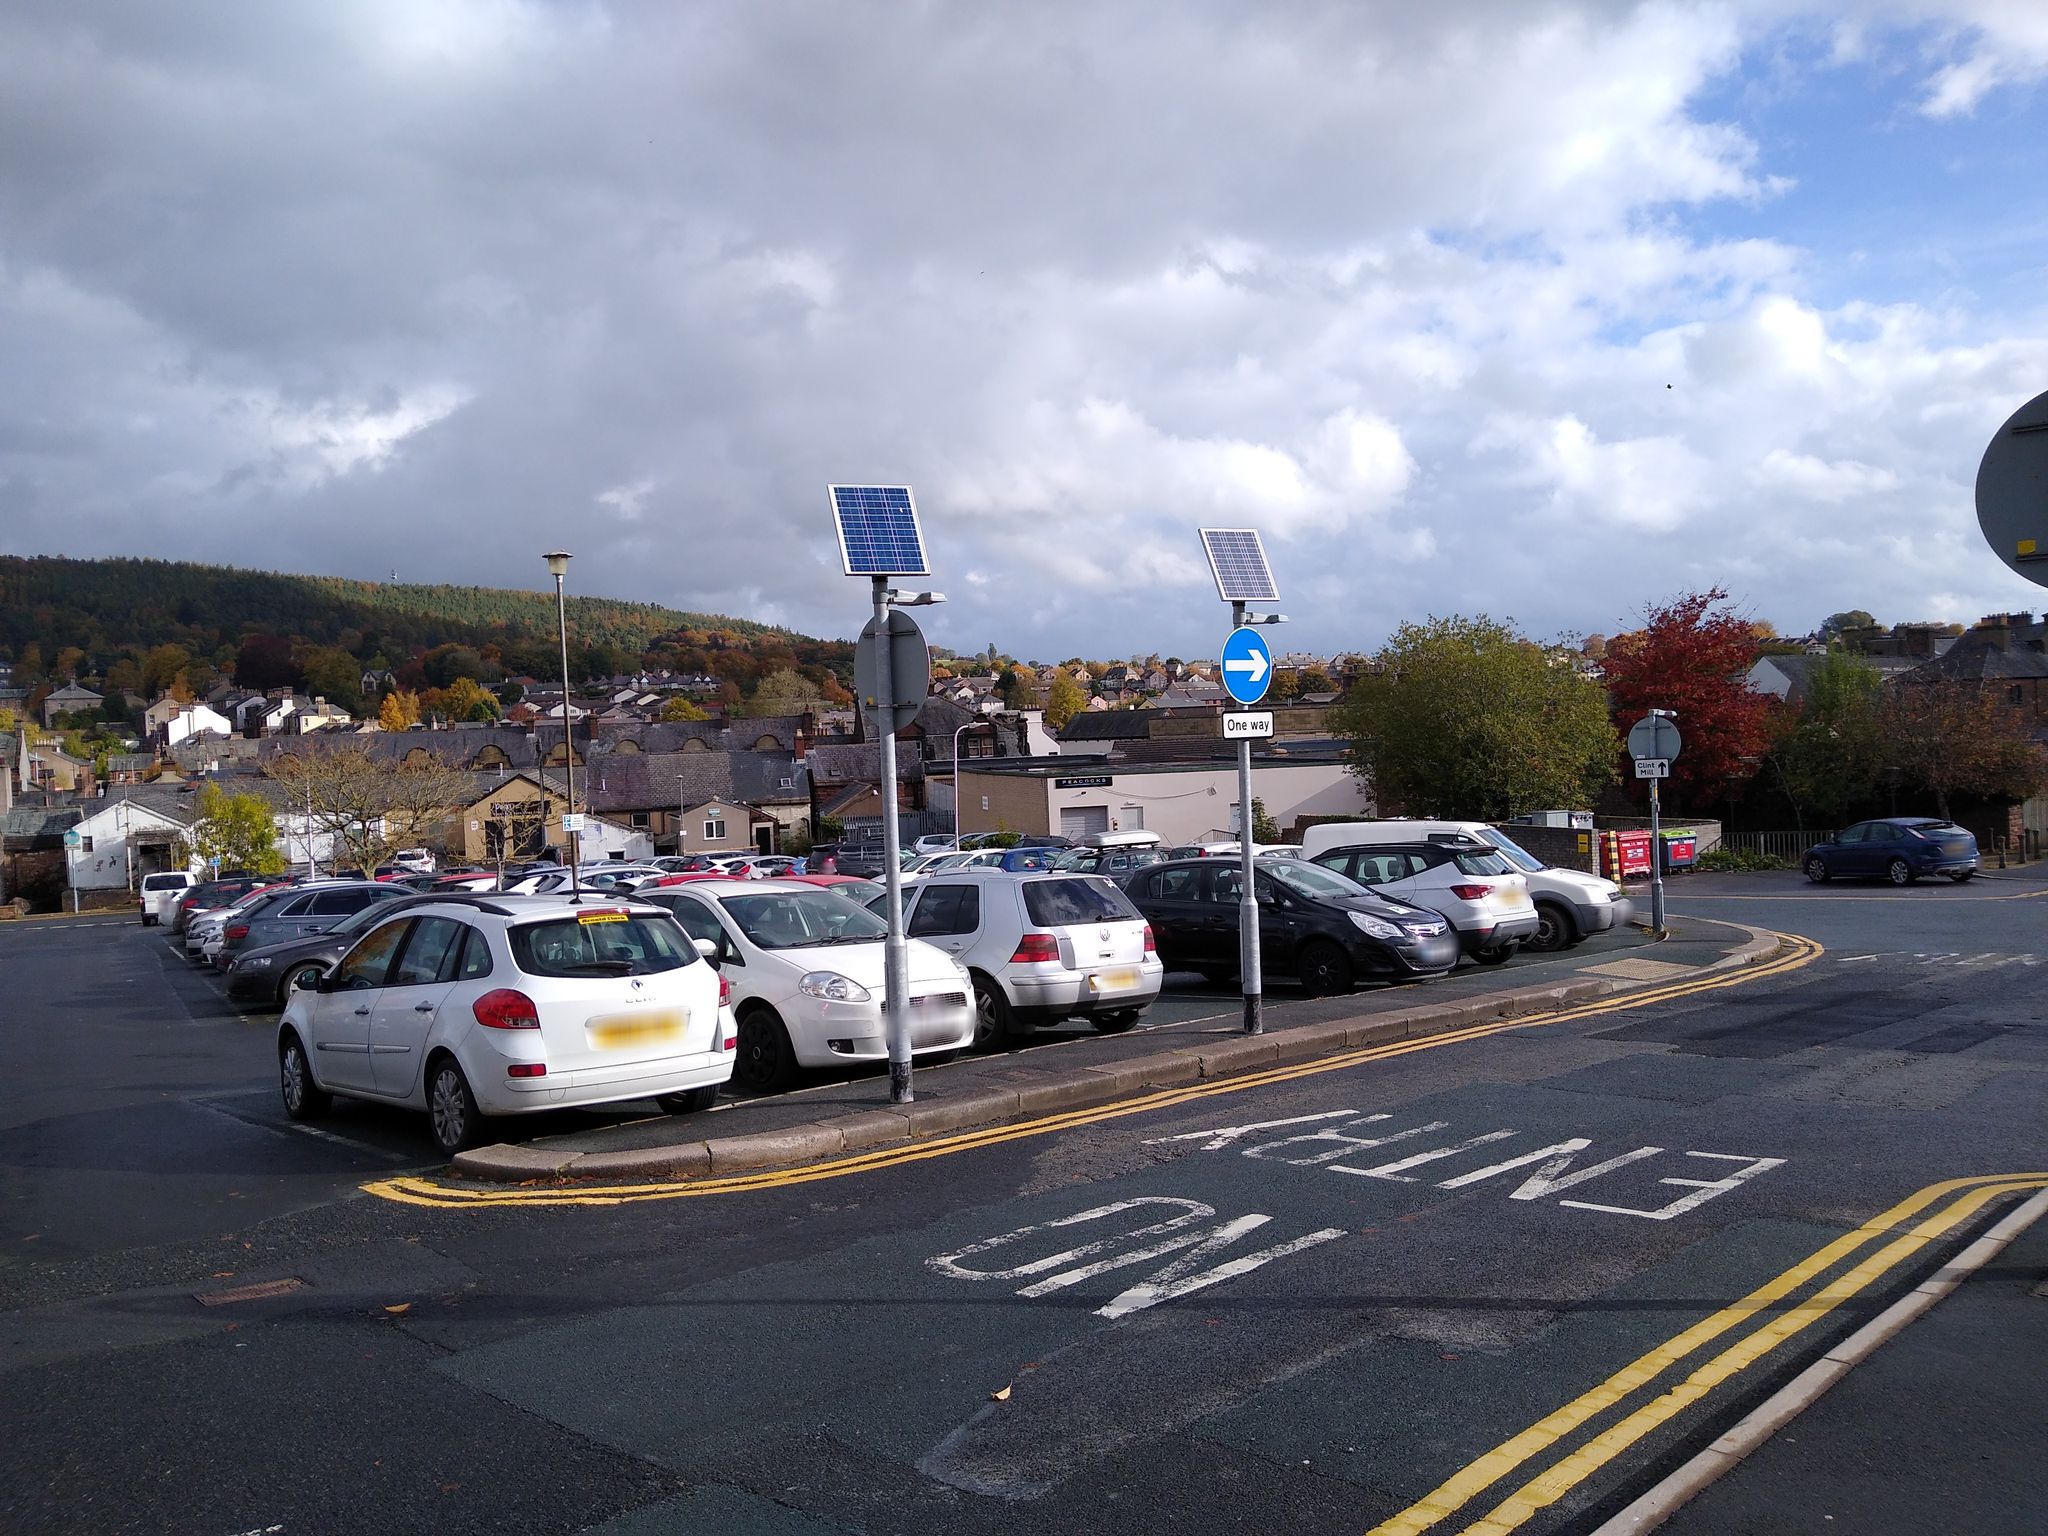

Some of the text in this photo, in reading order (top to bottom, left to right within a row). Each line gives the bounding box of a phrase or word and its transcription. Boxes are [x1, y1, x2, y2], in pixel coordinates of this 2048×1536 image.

[1227, 719, 1269, 732] One way
[1141, 1109, 1788, 1220] ENTRY
[924, 1196, 1348, 1319] NO
